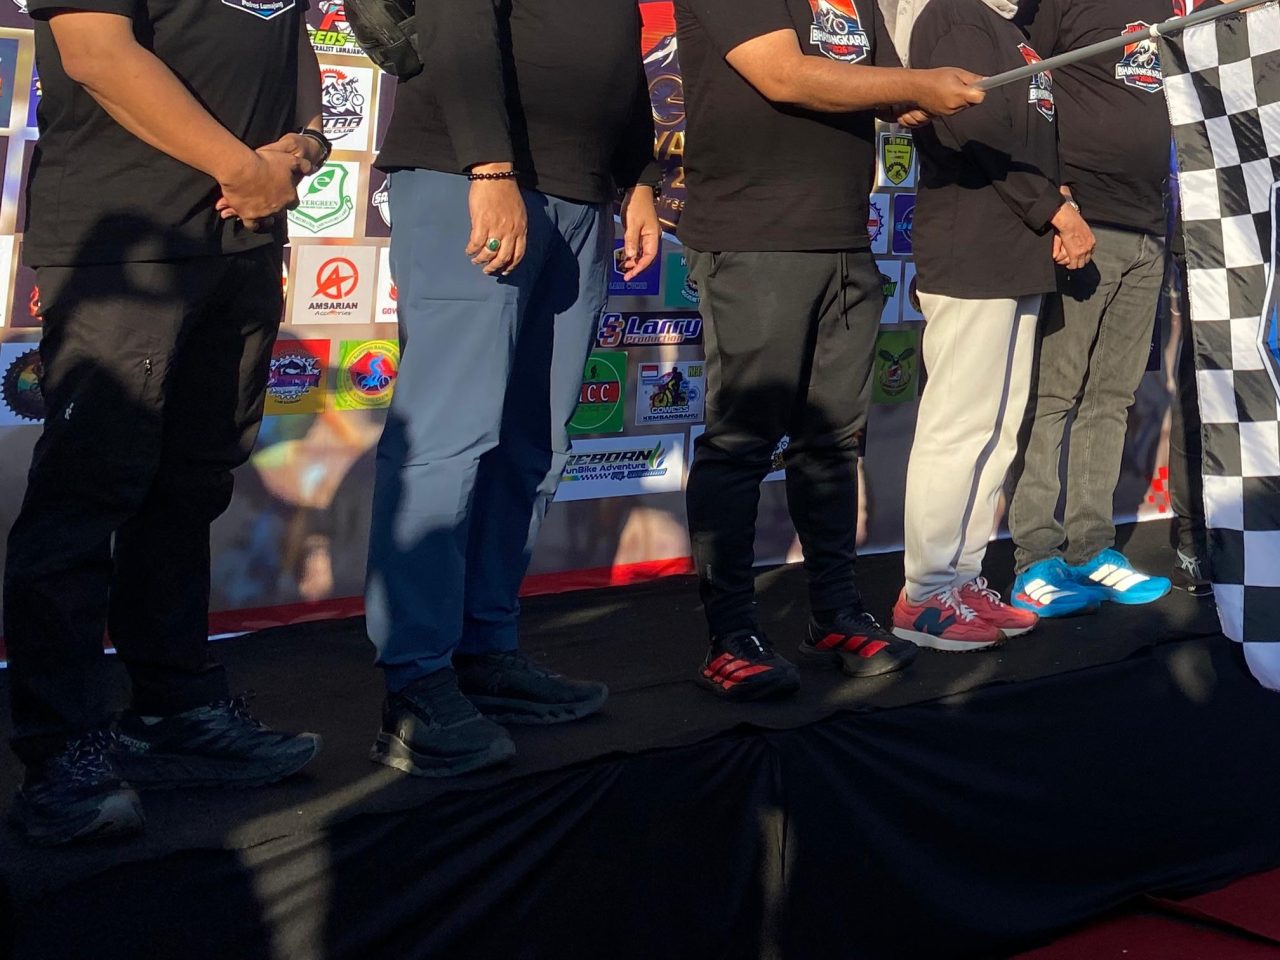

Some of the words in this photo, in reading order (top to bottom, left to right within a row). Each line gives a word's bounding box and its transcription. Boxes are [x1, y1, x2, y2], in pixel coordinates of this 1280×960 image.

[308, 302, 358, 310] AMSARIAN
[626, 316, 702, 338] Larry
[624, 334, 685, 344] Production
[565, 464, 597, 474] unBike
[599, 462, 646, 472] Adventure
